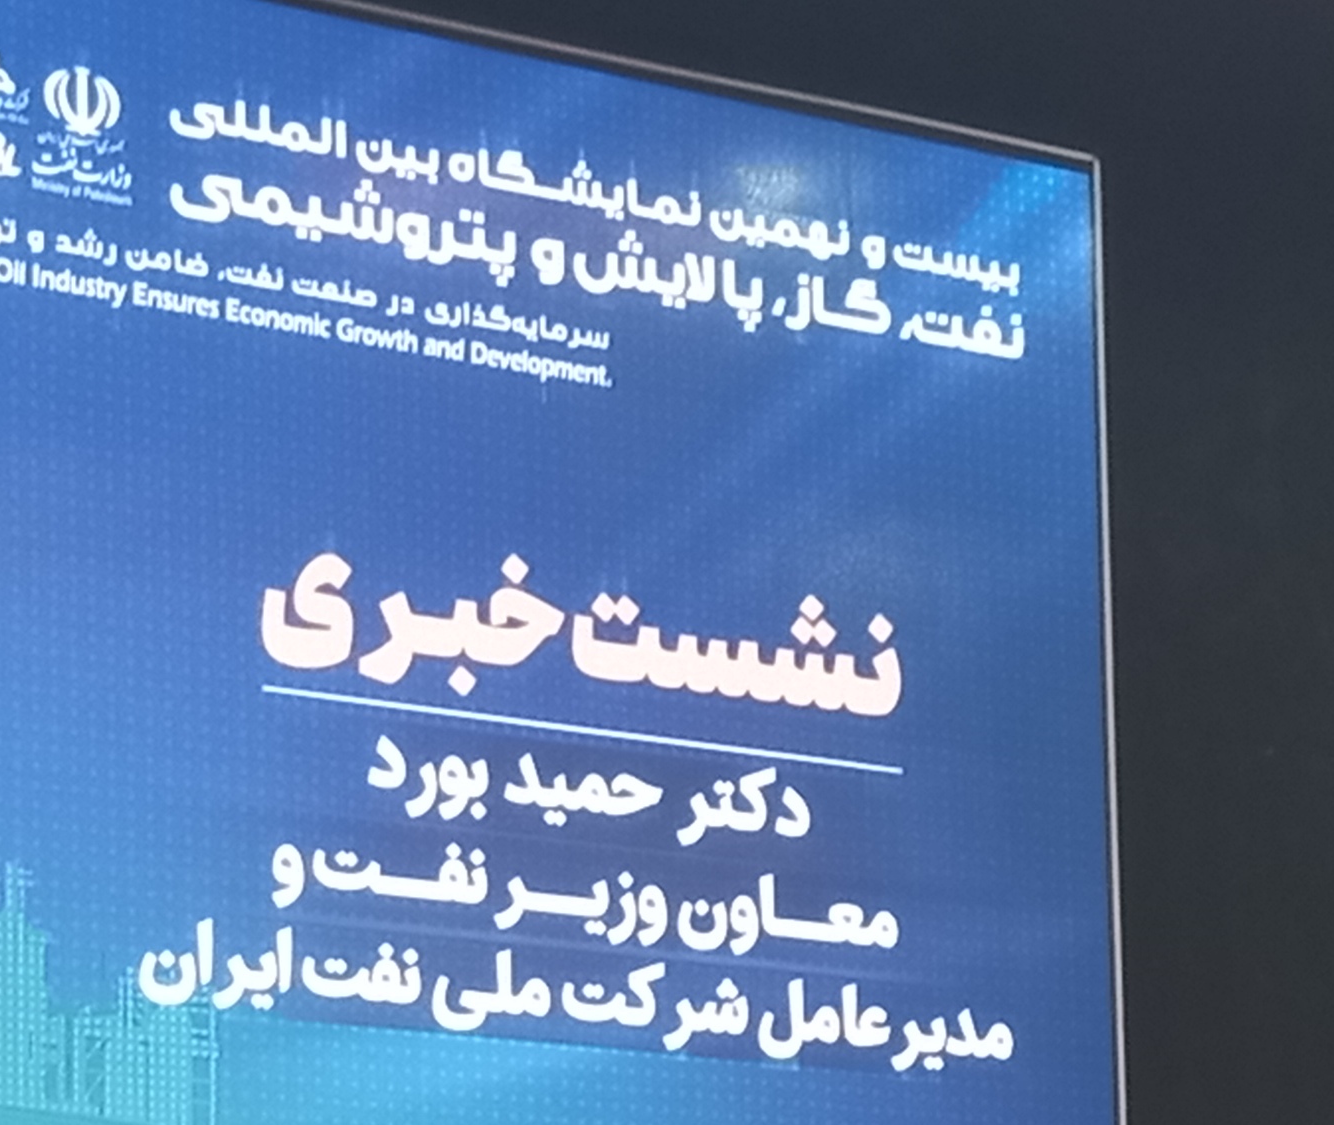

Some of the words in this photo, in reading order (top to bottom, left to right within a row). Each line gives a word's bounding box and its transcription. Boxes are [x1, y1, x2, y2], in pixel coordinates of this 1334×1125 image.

[169, 100, 347, 158] المللی
[355, 139, 440, 185] بین
[448, 148, 701, 226] نمایشگاه
[27, 230, 45, 253] و
[55, 227, 118, 266] رشد
[125, 245, 208, 277] ضامن
[169, 174, 516, 288] پتروشیمی
[531, 238, 565, 286] و
[709, 209, 850, 260] نهمین
[862, 235, 886, 270] و
[291, 275, 378, 308] صنعت
[573, 230, 763, 333] پالایش
[892, 242, 1021, 297] بیست
[32, 263, 127, 308] Industry
[132, 282, 219, 319] Ensures
[225, 298, 331, 339] Economic
[336, 318, 418, 354] Growth
[424, 336, 465, 362] and
[470, 341, 613, 388] Development.
[386, 293, 414, 316] در
[261, 552, 565, 696] خبری
[571, 592, 902, 717] نشست
[367, 734, 489, 820] بورد
[504, 753, 664, 827] حمید
[675, 767, 811, 847] دکتر
[271, 842, 304, 908] و
[311, 842, 488, 906] نفت
[494, 873, 667, 944] وزیر
[677, 874, 901, 958] معاون
[138, 918, 292, 1012] ایران
[301, 944, 422, 1004] نفت
[432, 950, 549, 1034] ملی
[562, 963, 750, 1049] شرکت
[757, 978, 891, 1062] عامل
[891, 1009, 1015, 1073] مدیر
